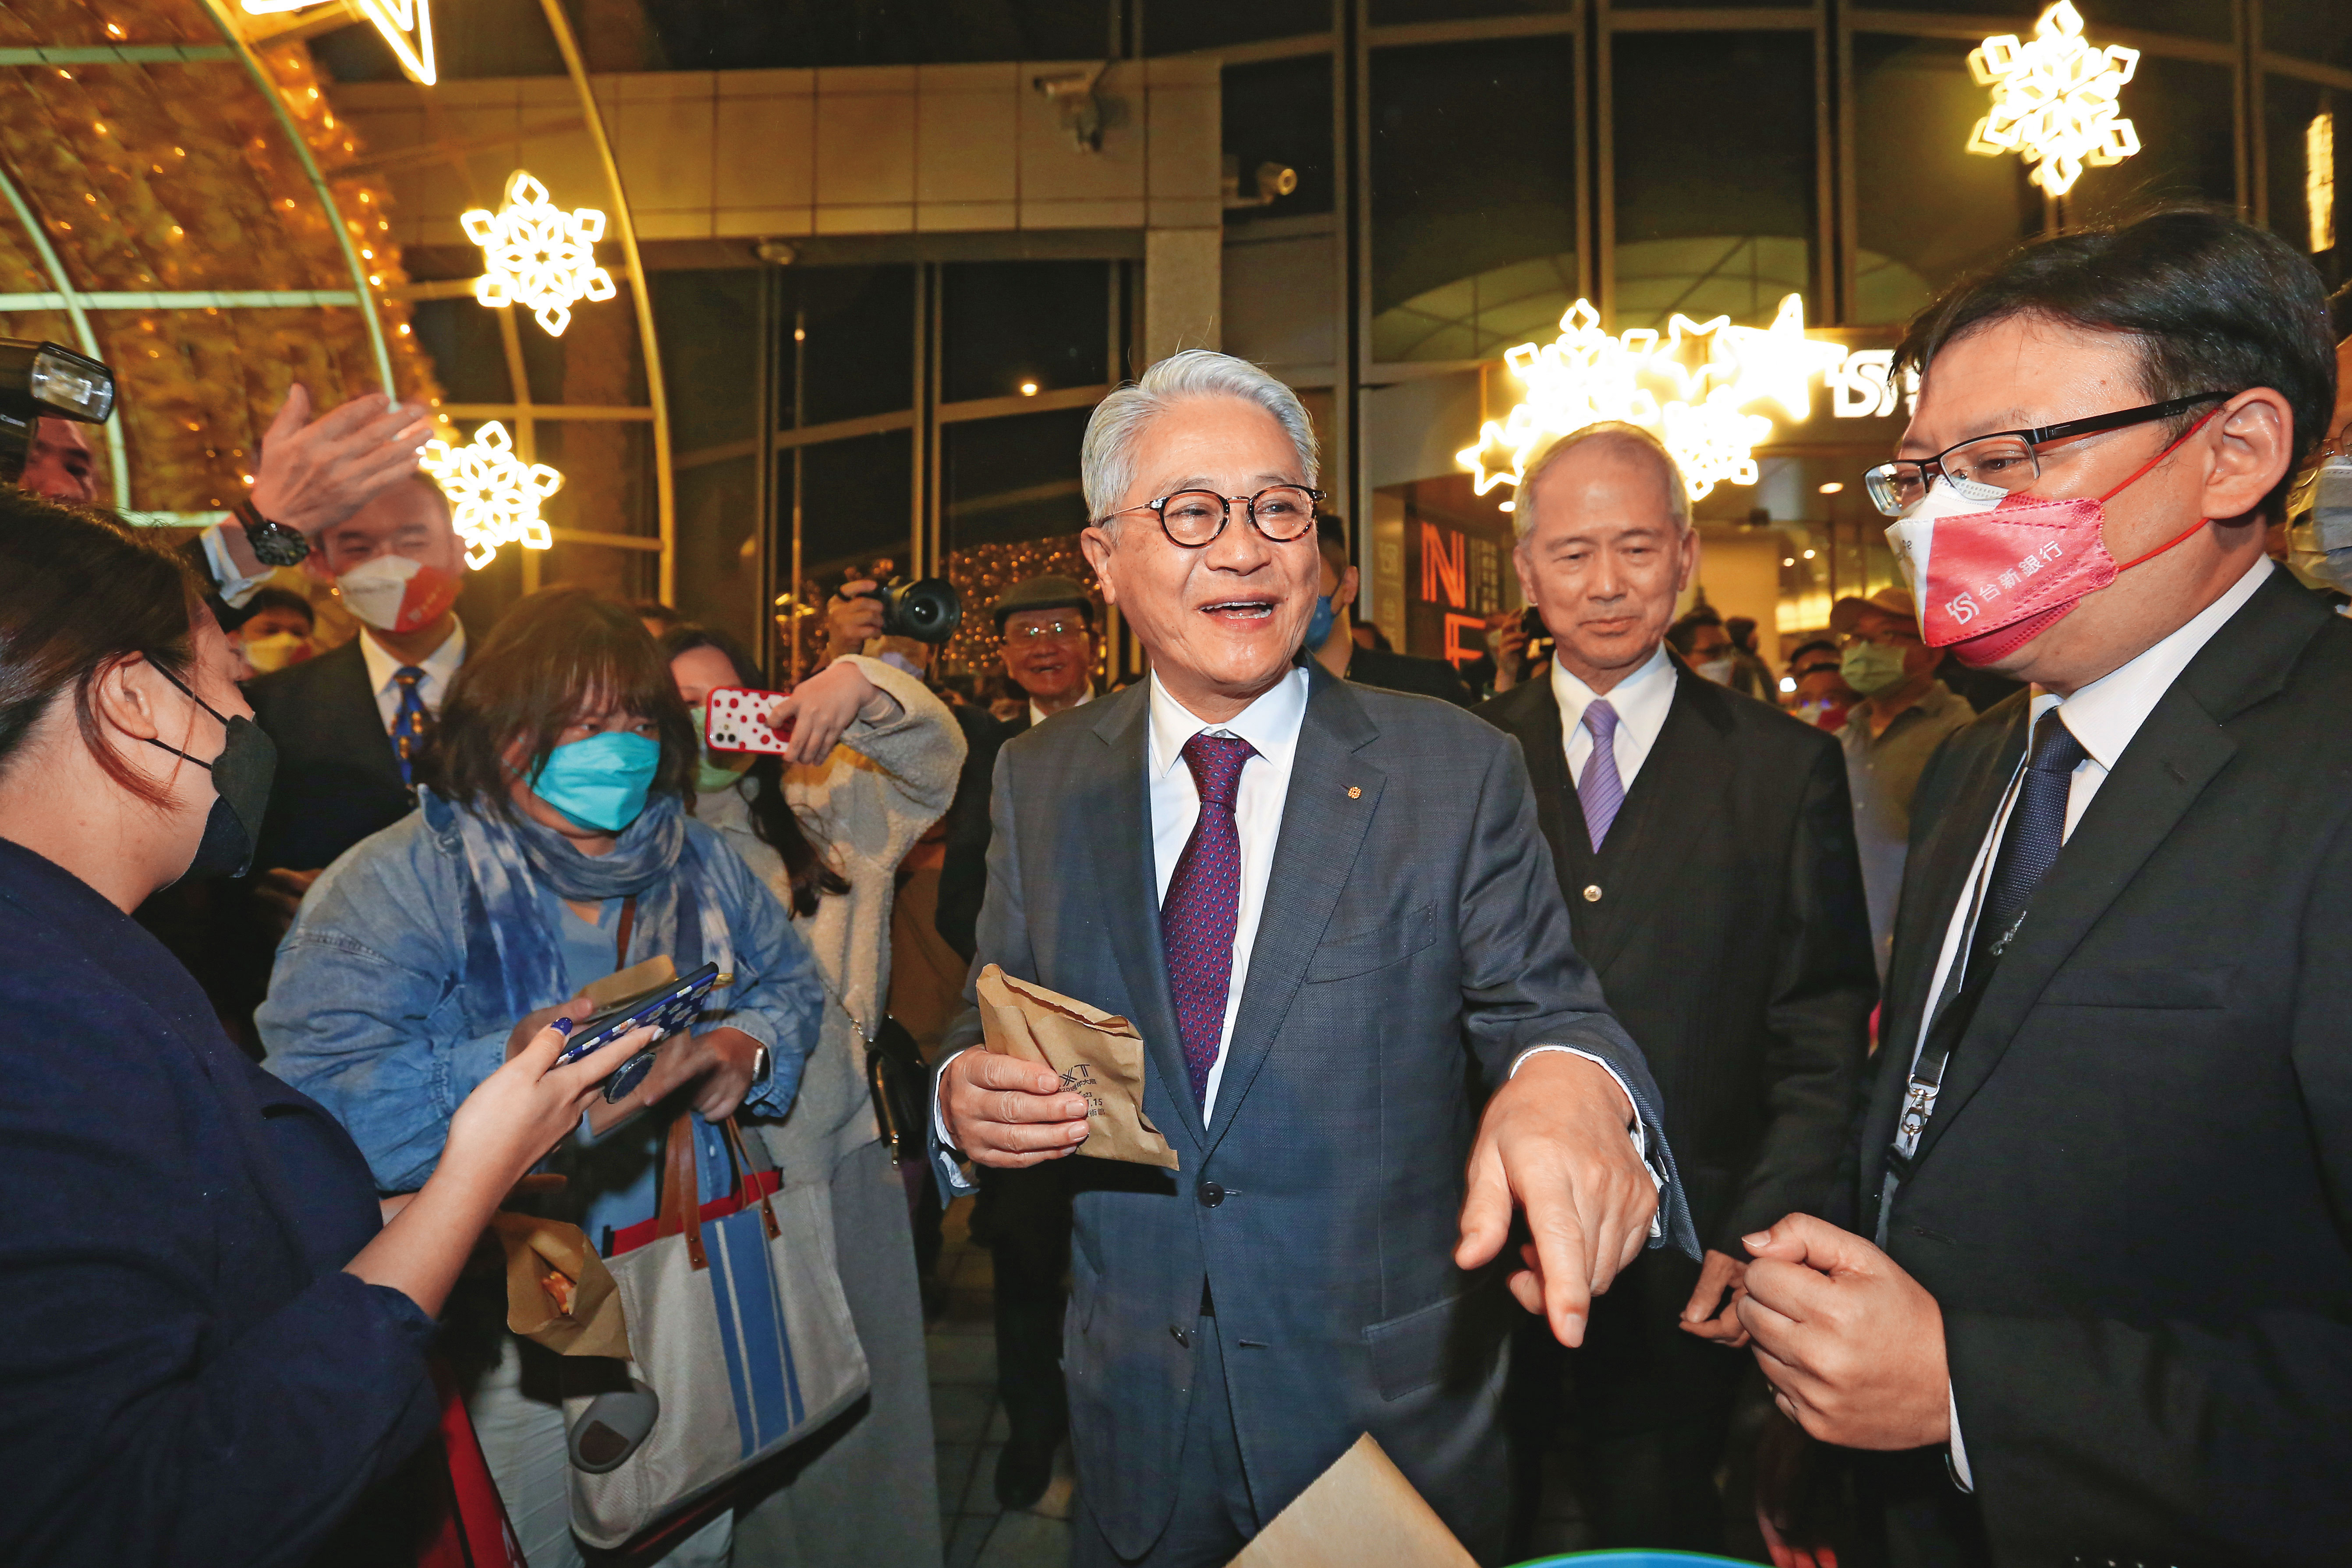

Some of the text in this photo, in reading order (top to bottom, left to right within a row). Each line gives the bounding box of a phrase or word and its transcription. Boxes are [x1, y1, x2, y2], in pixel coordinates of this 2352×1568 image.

[1422, 521, 1465, 609] N
[1979, 540, 2063, 602] 台新銀行
[1059, 1064, 1090, 1087] XT
[1059, 1079, 1097, 1092] 20週年大展
